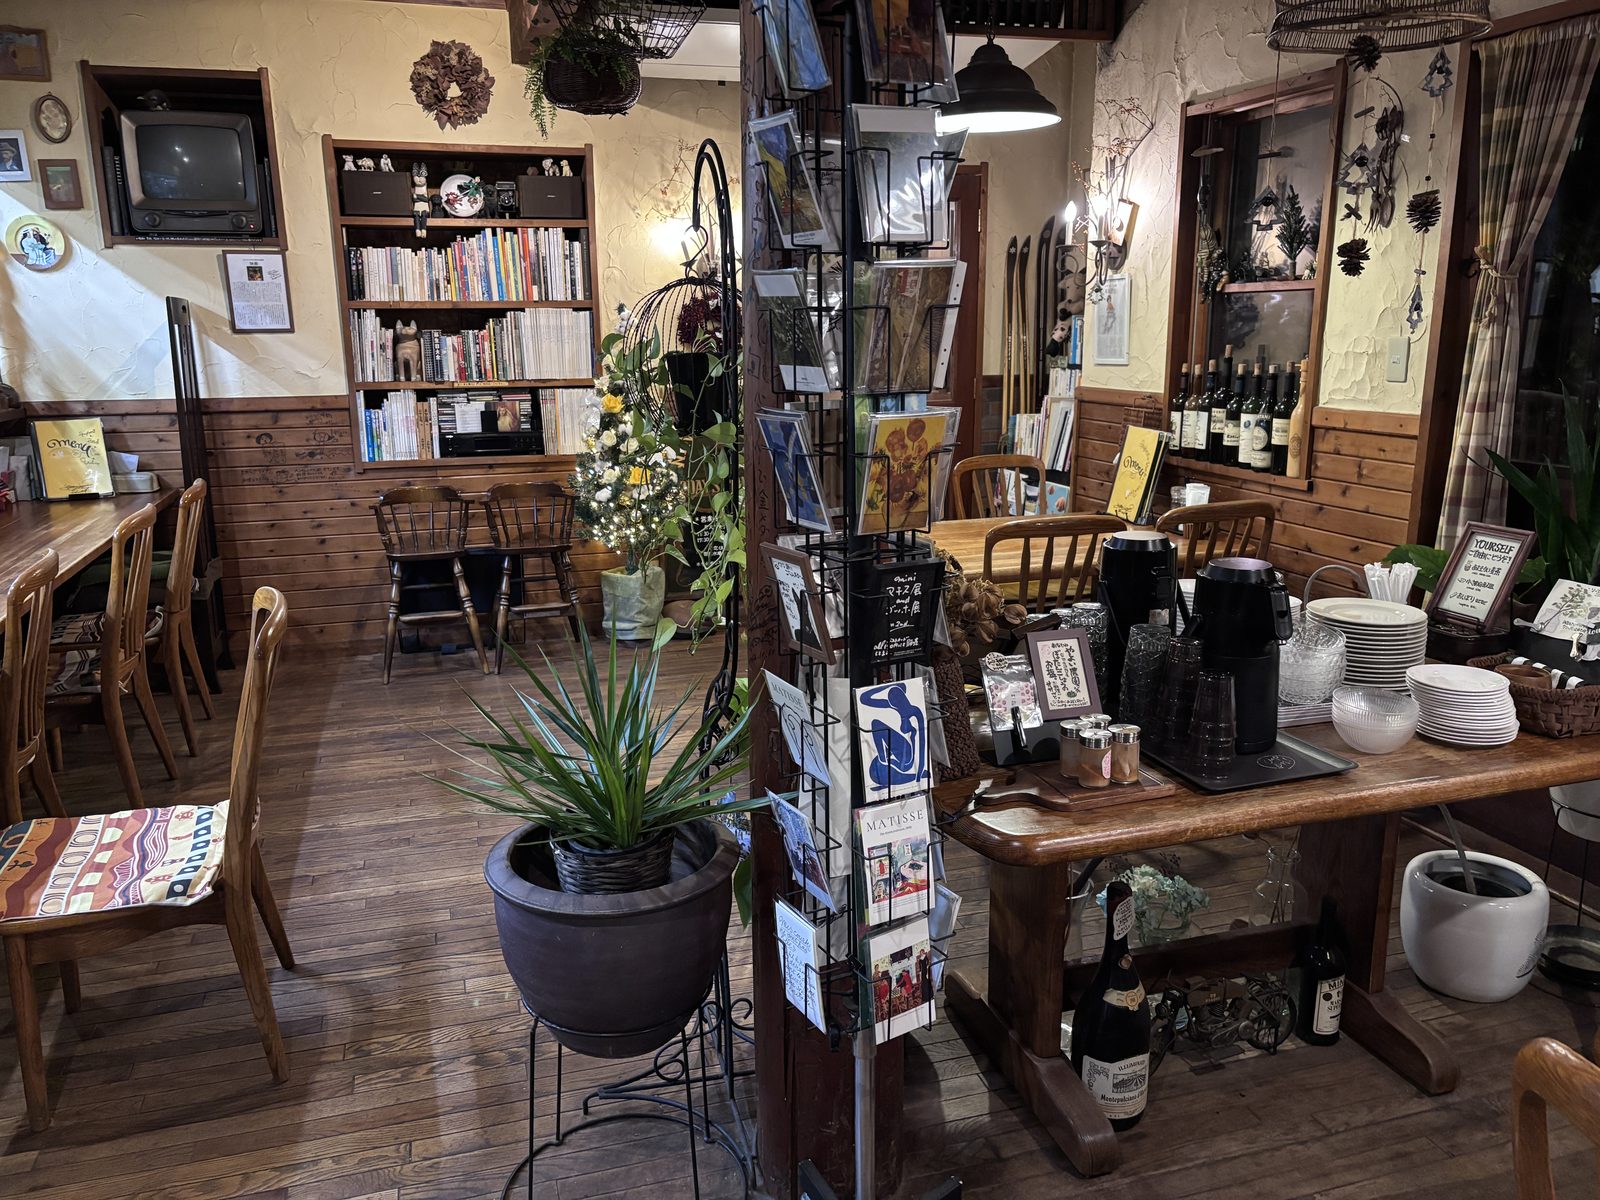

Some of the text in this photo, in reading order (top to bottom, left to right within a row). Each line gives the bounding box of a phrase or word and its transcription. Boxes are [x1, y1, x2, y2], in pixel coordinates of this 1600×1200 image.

[1474, 539, 1515, 554] YOURSELF
[894, 572, 917, 582] mini
[886, 582, 922, 597] マチス展
[896, 595, 911, 604] and
[770, 681, 804, 709] MATISSE
[866, 810, 924, 832] MATISSE
